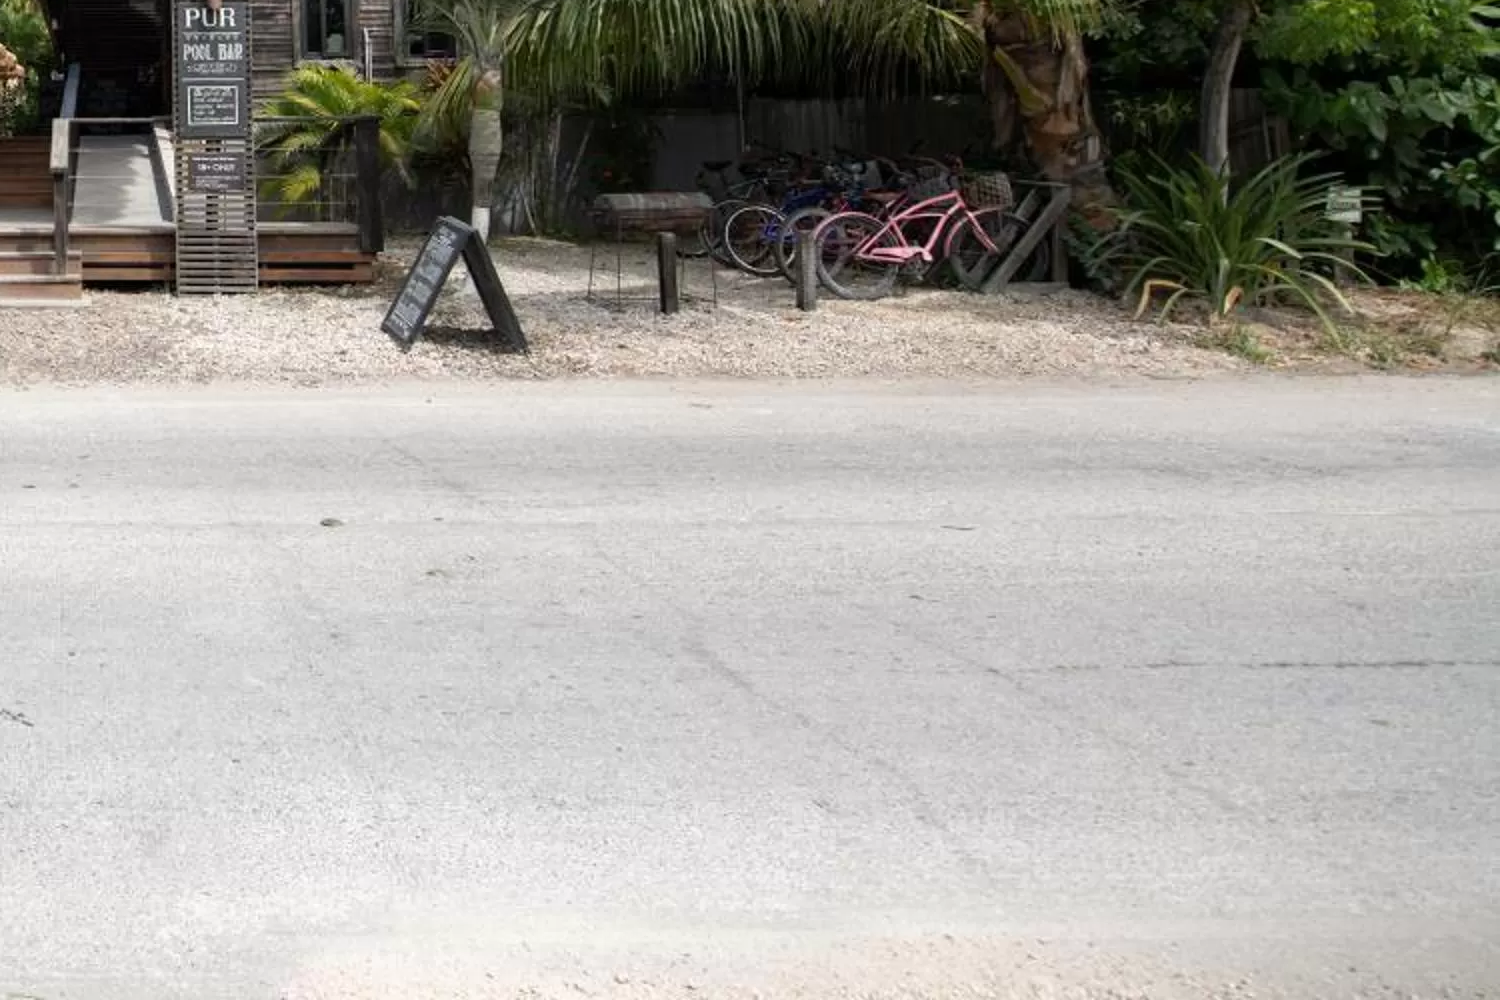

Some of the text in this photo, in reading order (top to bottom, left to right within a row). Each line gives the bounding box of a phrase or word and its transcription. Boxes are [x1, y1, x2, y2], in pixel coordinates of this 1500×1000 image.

[184, 7, 236, 28] PUR
[183, 43, 243, 61] POOL BAR
